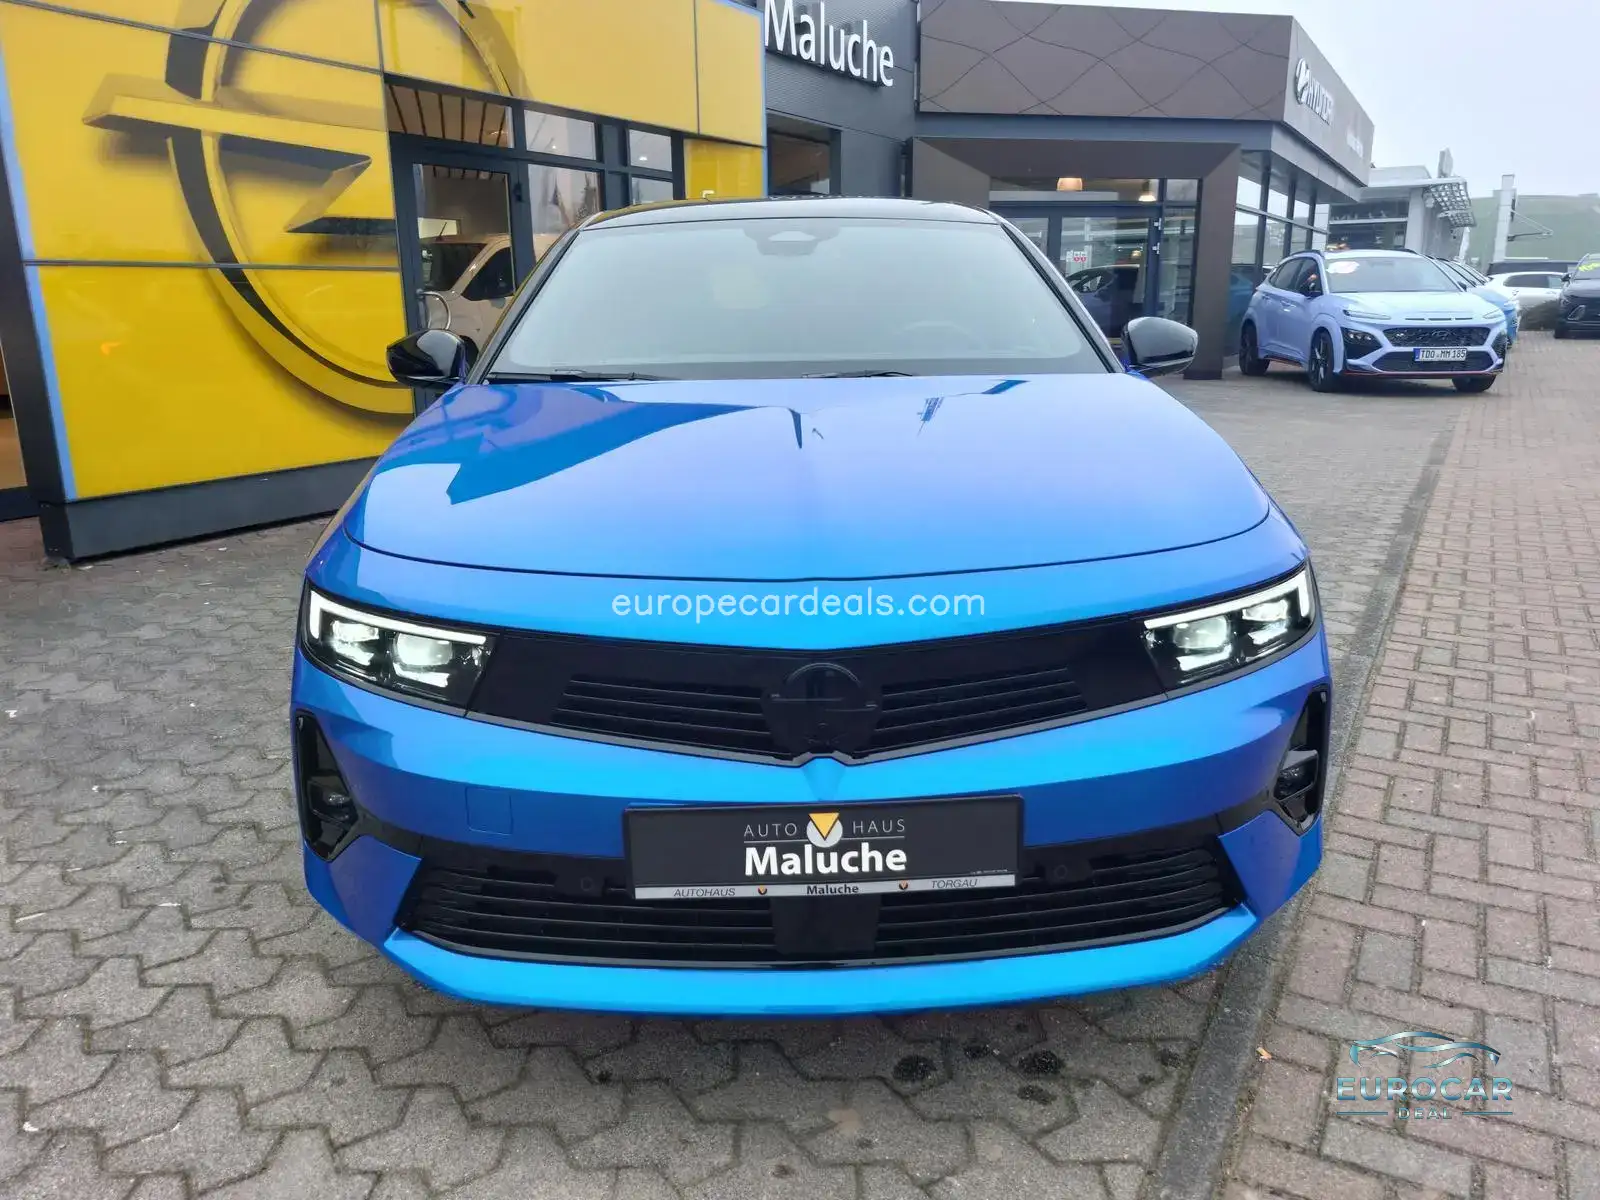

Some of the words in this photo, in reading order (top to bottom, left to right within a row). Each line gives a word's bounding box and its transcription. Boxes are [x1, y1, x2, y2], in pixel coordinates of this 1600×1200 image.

[764, 0, 894, 86] Maluche
[743, 822, 798, 838] AUTO
[852, 818, 906, 834] HAUS
[744, 842, 908, 876] Maluche
[673, 887, 736, 898] AUTOHAUS
[806, 883, 860, 896] Maluche
[931, 878, 979, 889] TORGAU
